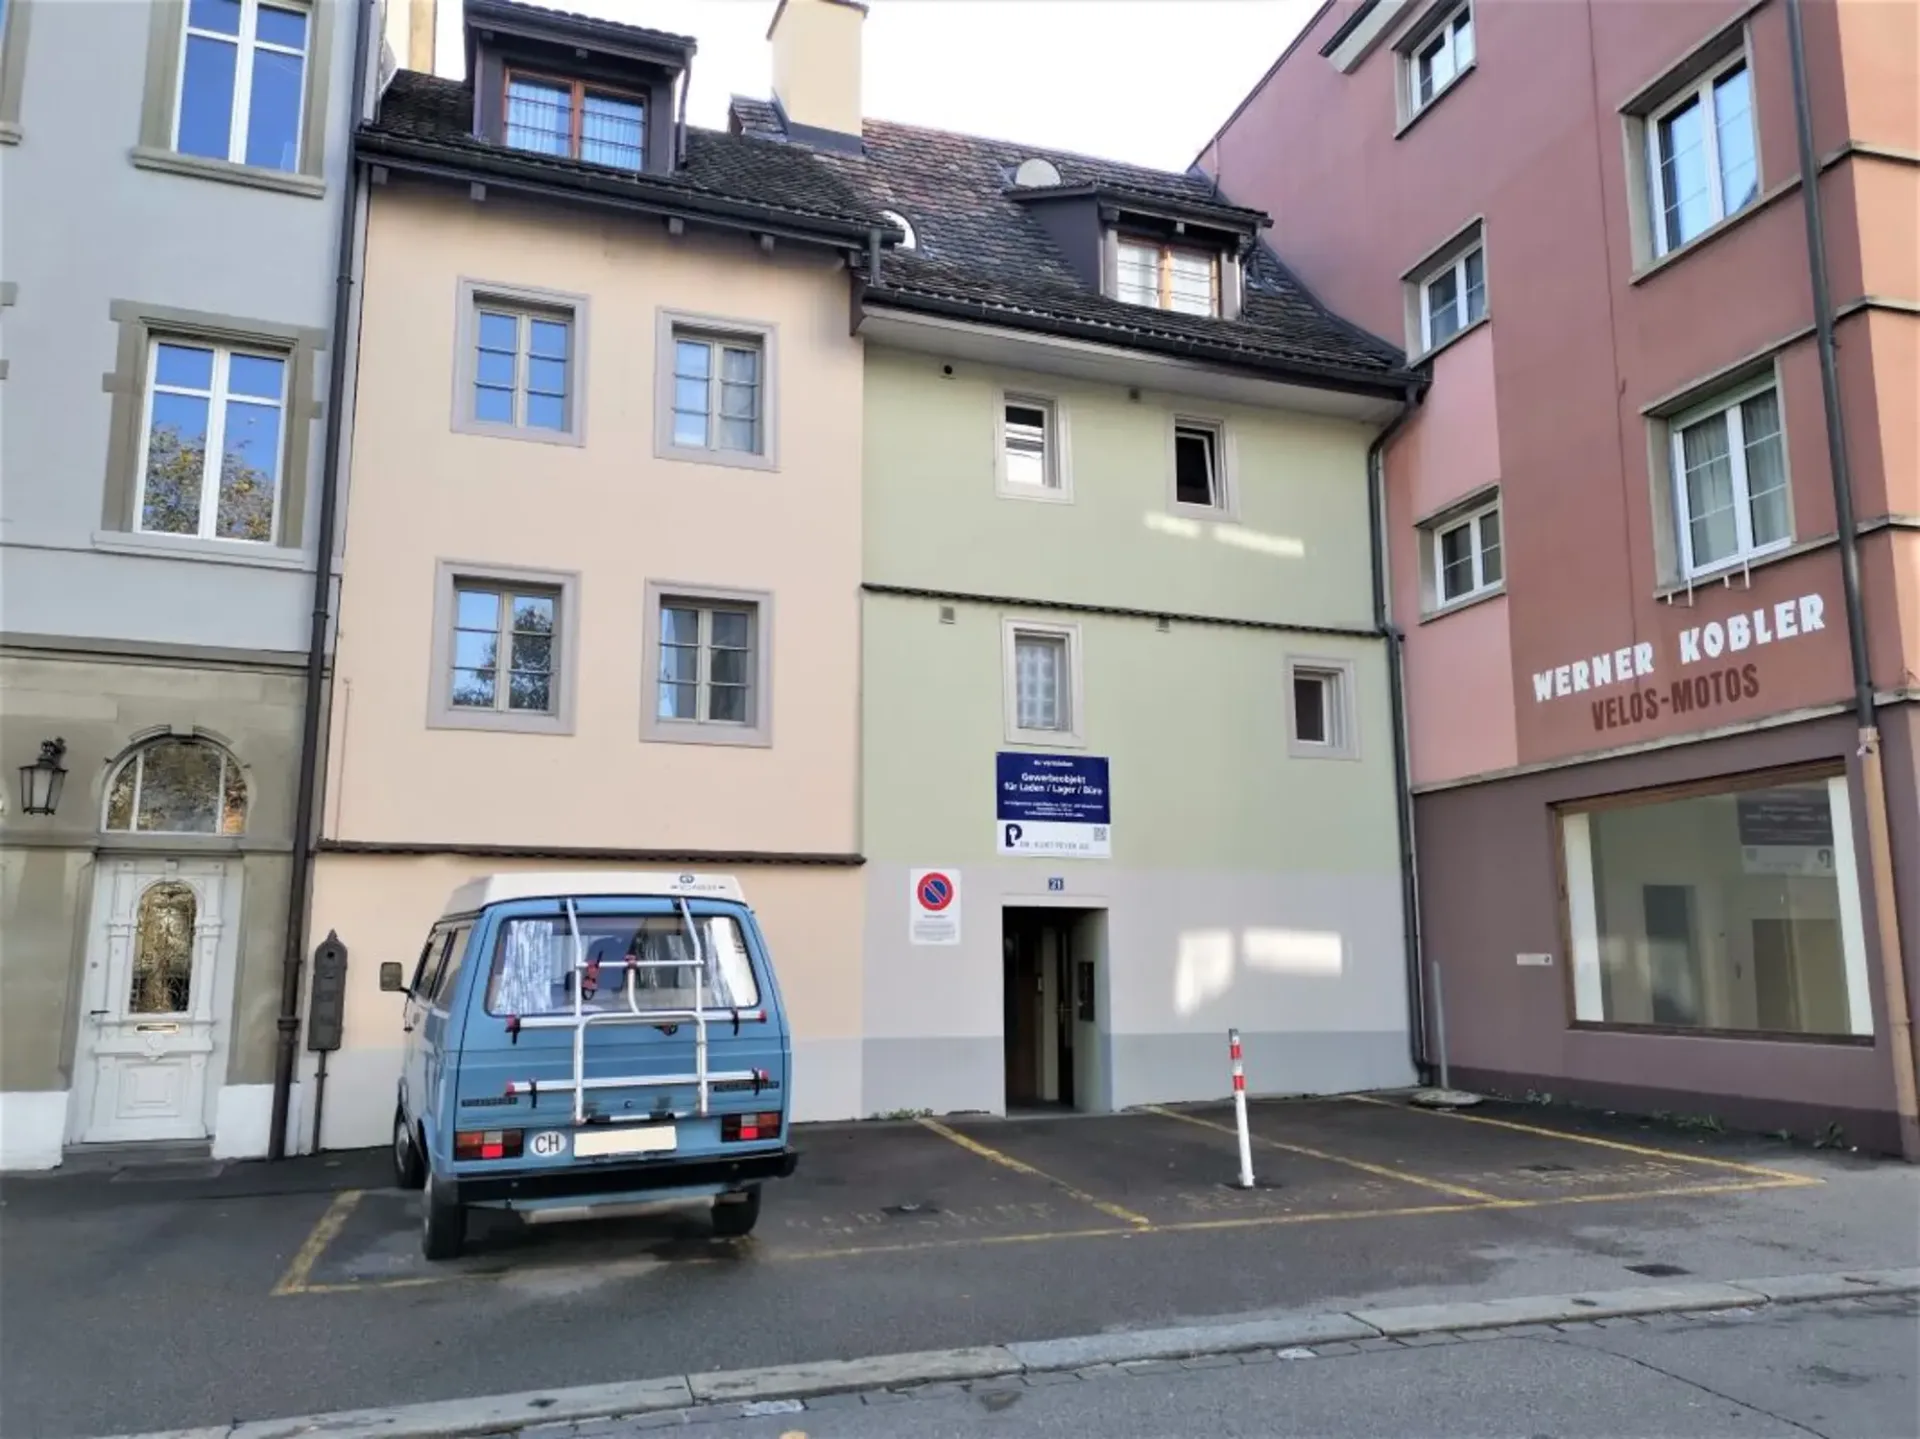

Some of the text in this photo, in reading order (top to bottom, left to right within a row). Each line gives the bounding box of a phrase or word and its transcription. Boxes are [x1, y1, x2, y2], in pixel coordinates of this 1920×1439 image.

[1533, 594, 1825, 702] WERNER KOBLER
[1591, 663, 1759, 732] VELOS-MOTOS
[1004, 781, 1017, 791] für
[1052, 784, 1076, 796] Lager
[1083, 785, 1103, 795] Büro
[535, 1134, 560, 1154] CH
